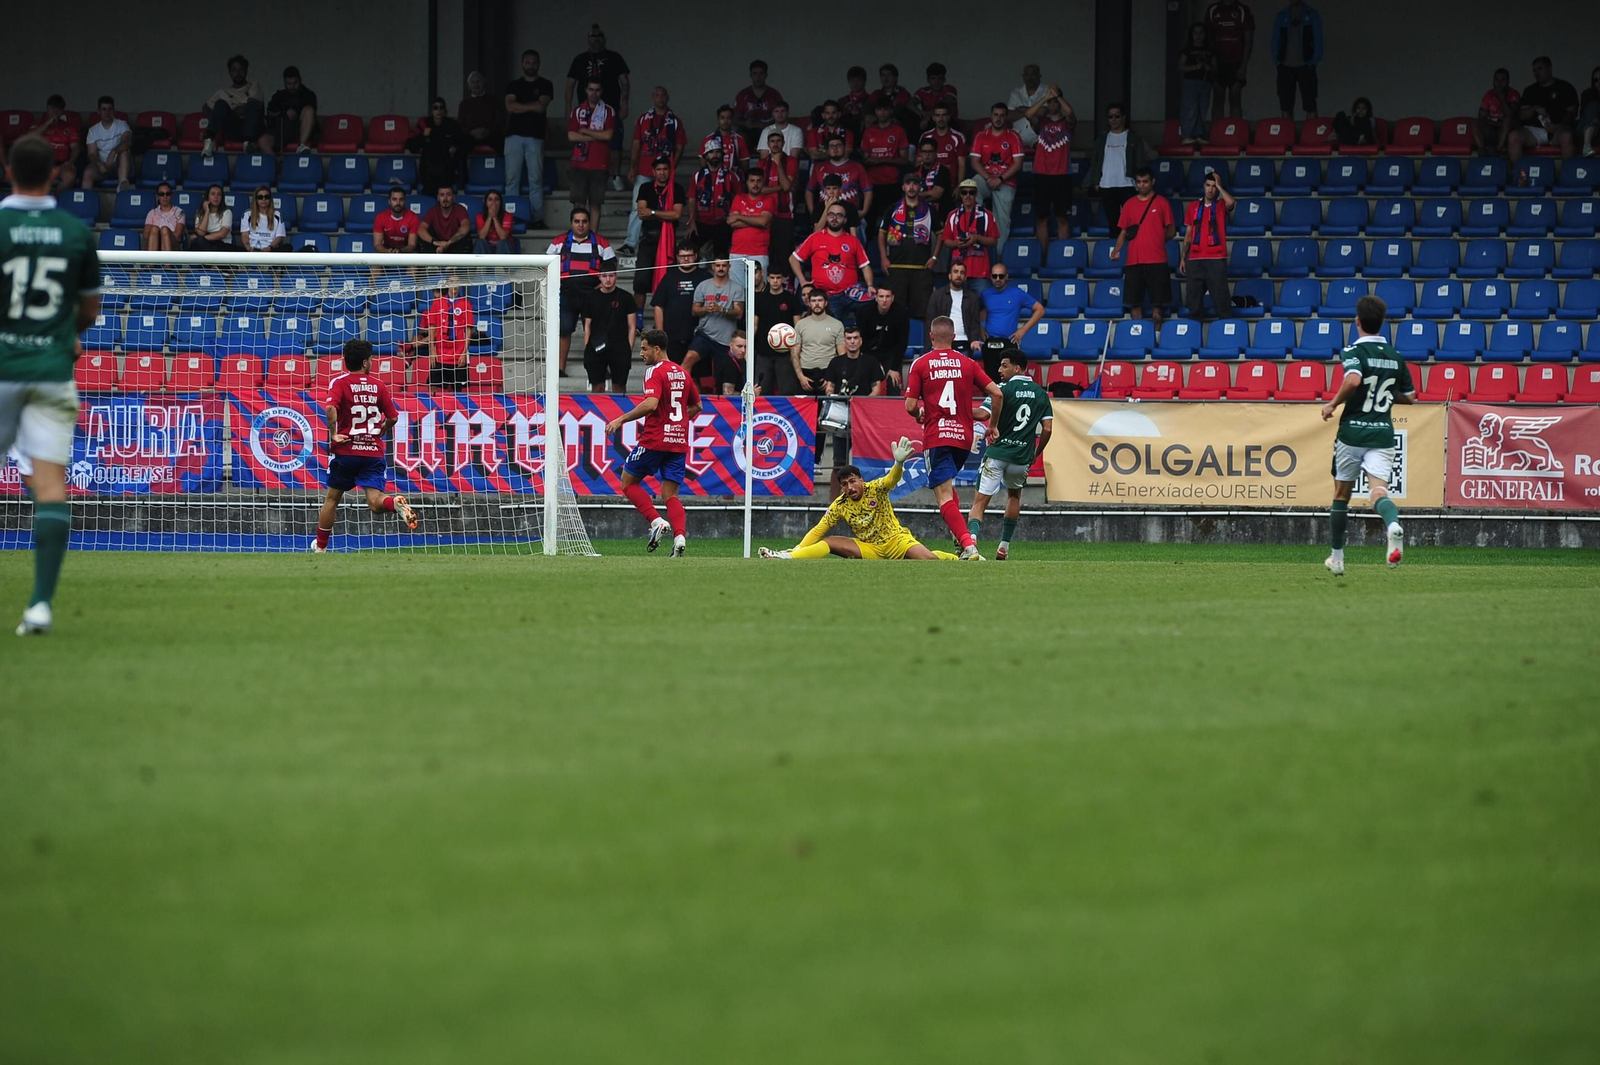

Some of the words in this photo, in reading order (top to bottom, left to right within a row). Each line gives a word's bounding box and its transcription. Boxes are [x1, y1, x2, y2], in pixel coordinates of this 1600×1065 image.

[2, 255, 68, 321] 15
[929, 369, 963, 381] LABRADA
[669, 391, 683, 422] 5
[938, 380, 957, 416] 4
[1362, 375, 1396, 413] 16
[86, 405, 206, 458] AURIA
[349, 405, 381, 436] 22
[757, 415, 794, 438] DEPORTIVA
[1012, 403, 1031, 432] 9
[93, 465, 174, 484] OURENSE
[1088, 442, 1298, 478] SOLGALEO
[1088, 482, 1298, 500] #AEnerxíadeOURENSE
[1460, 479, 1565, 502] GENERALI
